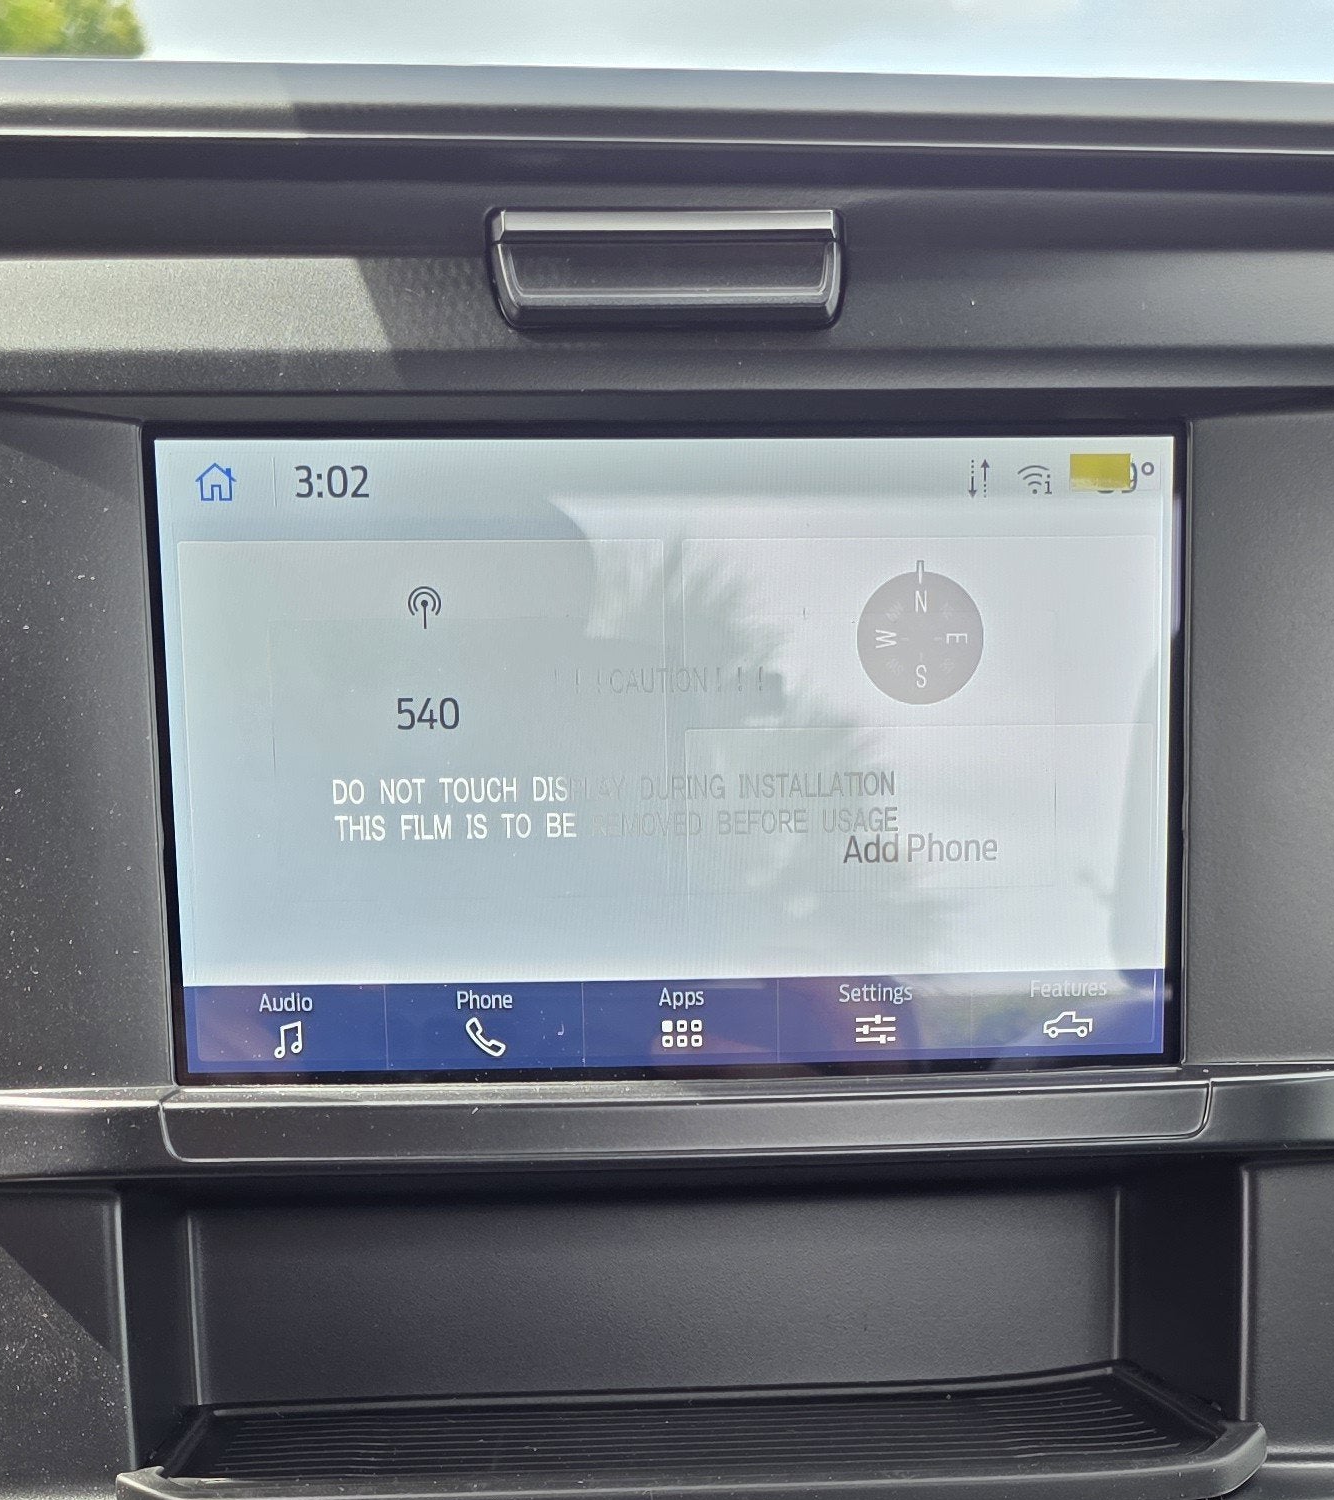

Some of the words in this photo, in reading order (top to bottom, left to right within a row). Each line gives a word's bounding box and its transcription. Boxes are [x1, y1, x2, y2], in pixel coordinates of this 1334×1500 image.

[294, 464, 370, 499] 3:02
[915, 590, 927, 613] N
[875, 629, 897, 649] W
[916, 664, 927, 688] S
[396, 696, 460, 730] 540
[332, 779, 365, 805] DO
[380, 778, 425, 804] NOT
[439, 777, 517, 803] TOUCH
[641, 774, 725, 800] DURING
[738, 771, 895, 799] INSTALLATION
[334, 815, 386, 841] THIS
[400, 814, 452, 841] FILM
[466, 813, 488, 839] IS
[501, 813, 531, 838] TO
[546, 812, 577, 838] BE
[718, 809, 808, 835] BEFORE
[822, 807, 898, 833] USAGE
[843, 833, 899, 864] Add
[907, 832, 998, 863] Phone
[456, 990, 513, 1010] Phone
[659, 986, 705, 1009] Apps
[838, 983, 913, 1005] Settings
[1029, 979, 1108, 998] Features
[259, 992, 313, 1012] Audio
